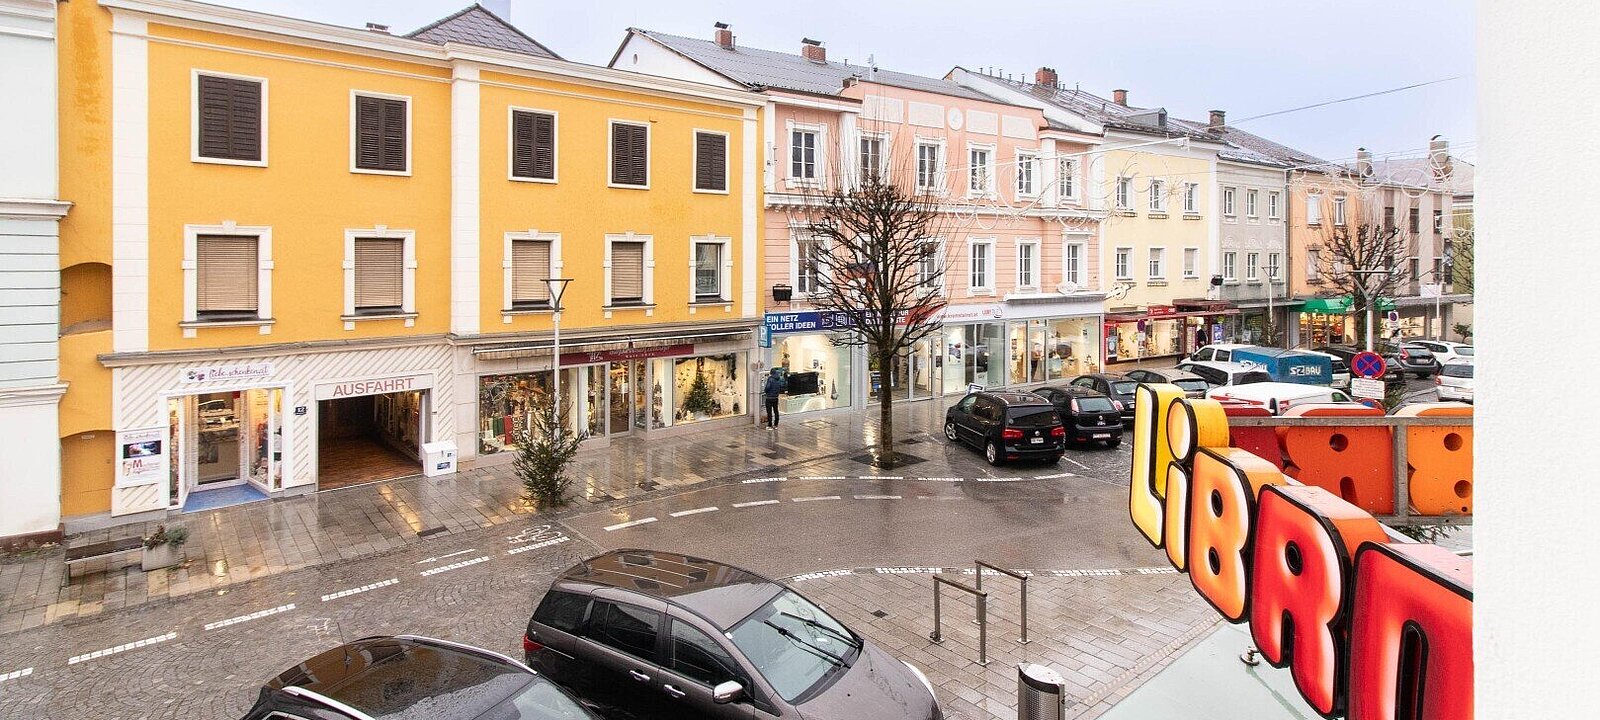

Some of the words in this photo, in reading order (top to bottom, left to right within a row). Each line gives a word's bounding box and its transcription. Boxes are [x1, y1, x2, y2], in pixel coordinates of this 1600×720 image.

[766, 315, 779, 323] EIN
[780, 314, 799, 322] NETZ
[795, 321, 816, 329] IDEEN
[333, 377, 415, 397] AUSFAHRT
